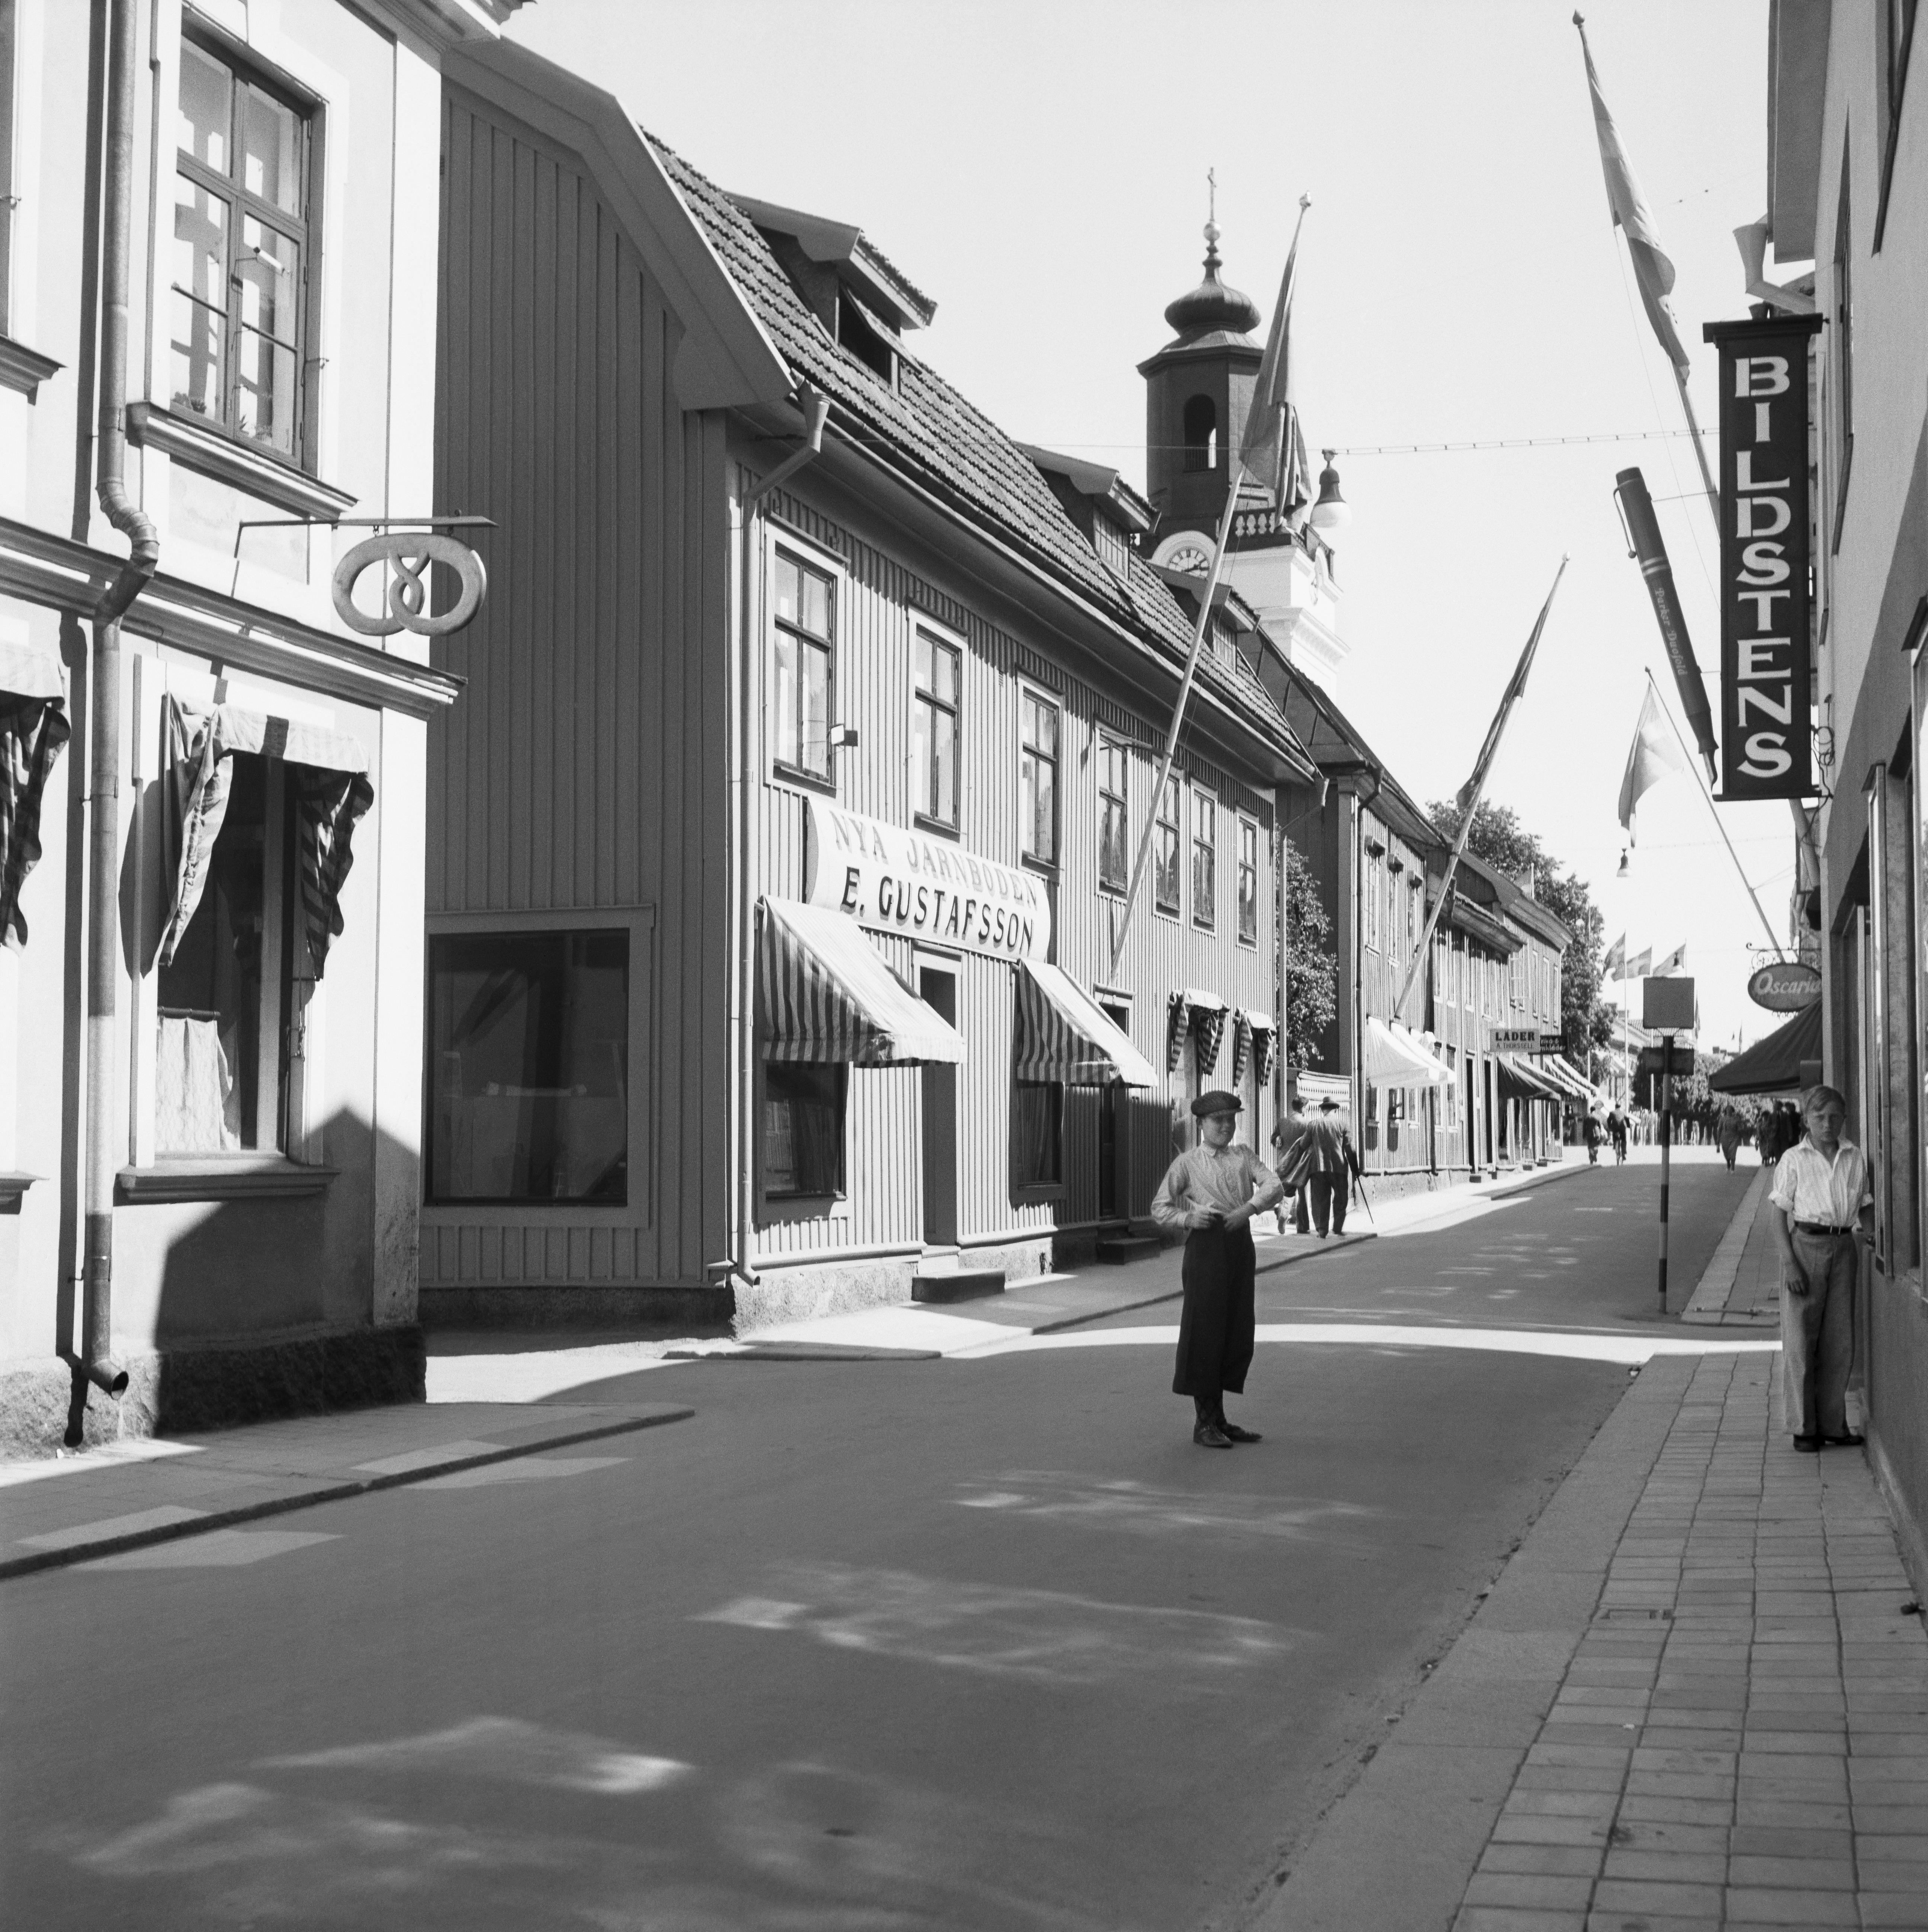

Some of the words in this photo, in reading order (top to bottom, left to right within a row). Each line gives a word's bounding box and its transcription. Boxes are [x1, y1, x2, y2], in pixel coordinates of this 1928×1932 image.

[1735, 356, 1792, 778] BILDSTENS
[1655, 587, 1671, 626] Parker
[1666, 630, 1688, 676] Duofold
[829, 810, 889, 864] NYA
[840, 866, 865, 917] E.
[878, 875, 1037, 956] GUSTAFSSON
